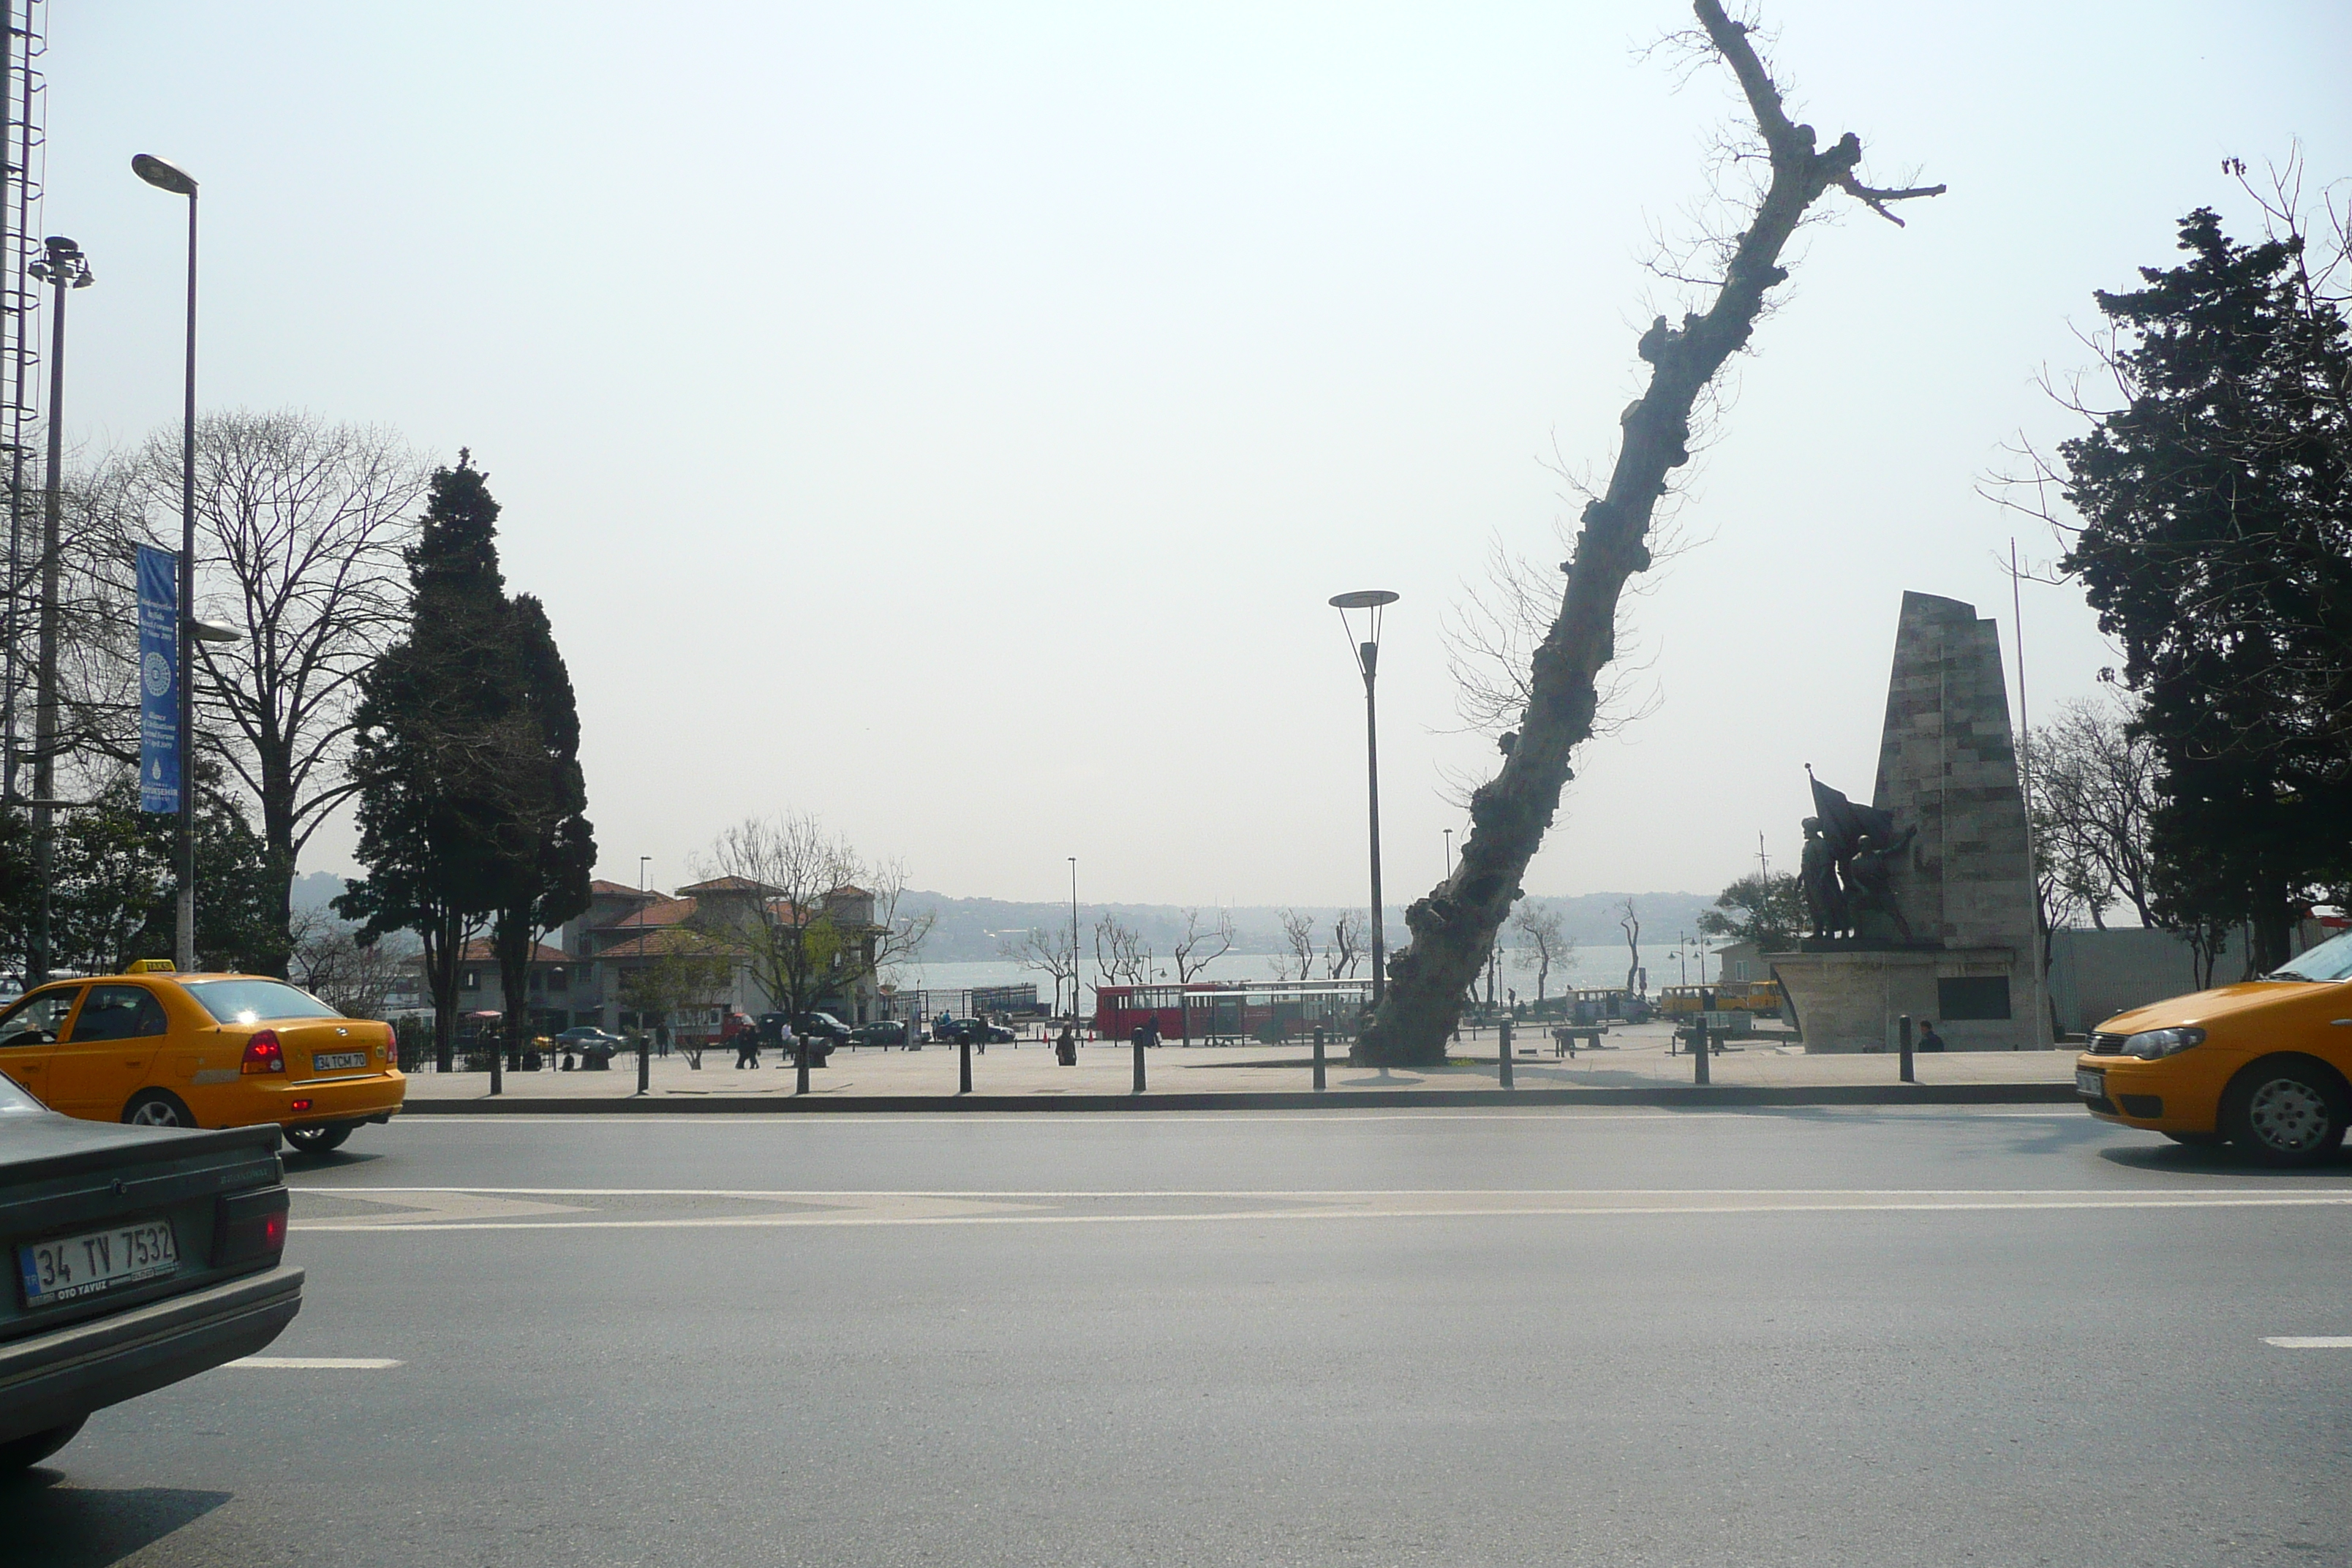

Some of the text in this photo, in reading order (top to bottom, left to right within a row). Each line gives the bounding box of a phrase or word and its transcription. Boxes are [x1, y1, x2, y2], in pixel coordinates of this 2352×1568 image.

[318, 1054, 365, 1068] 34 TCM 70
[37, 1224, 173, 1286] 34 TV 7532
[58, 1288, 77, 1300] OTO
[78, 1280, 107, 1295] YAVUZ
